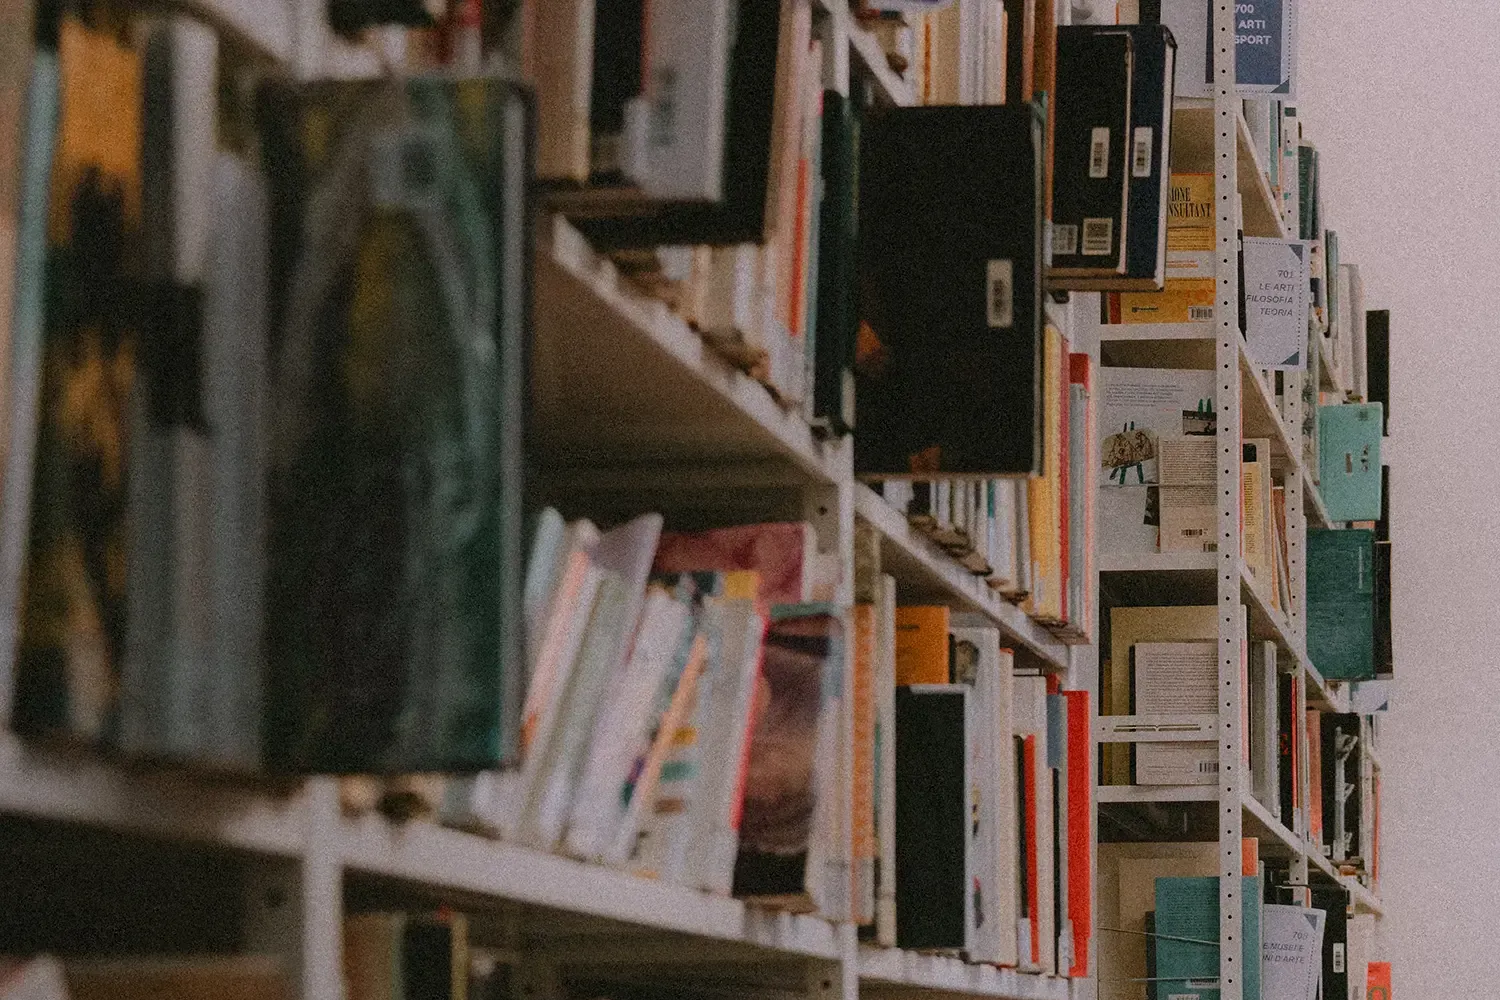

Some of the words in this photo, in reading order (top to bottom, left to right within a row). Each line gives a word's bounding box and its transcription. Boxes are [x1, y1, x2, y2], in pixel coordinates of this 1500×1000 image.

[1235, 4, 1254, 14] 700
[1238, 19, 1266, 29] ARTI
[1235, 34, 1272, 45] SPORT
[1259, 283, 1271, 291] LE
[1273, 283, 1295, 292] ARTI
[1246, 294, 1294, 305] FILOSOFIA
[1260, 307, 1294, 317] TEORIA
